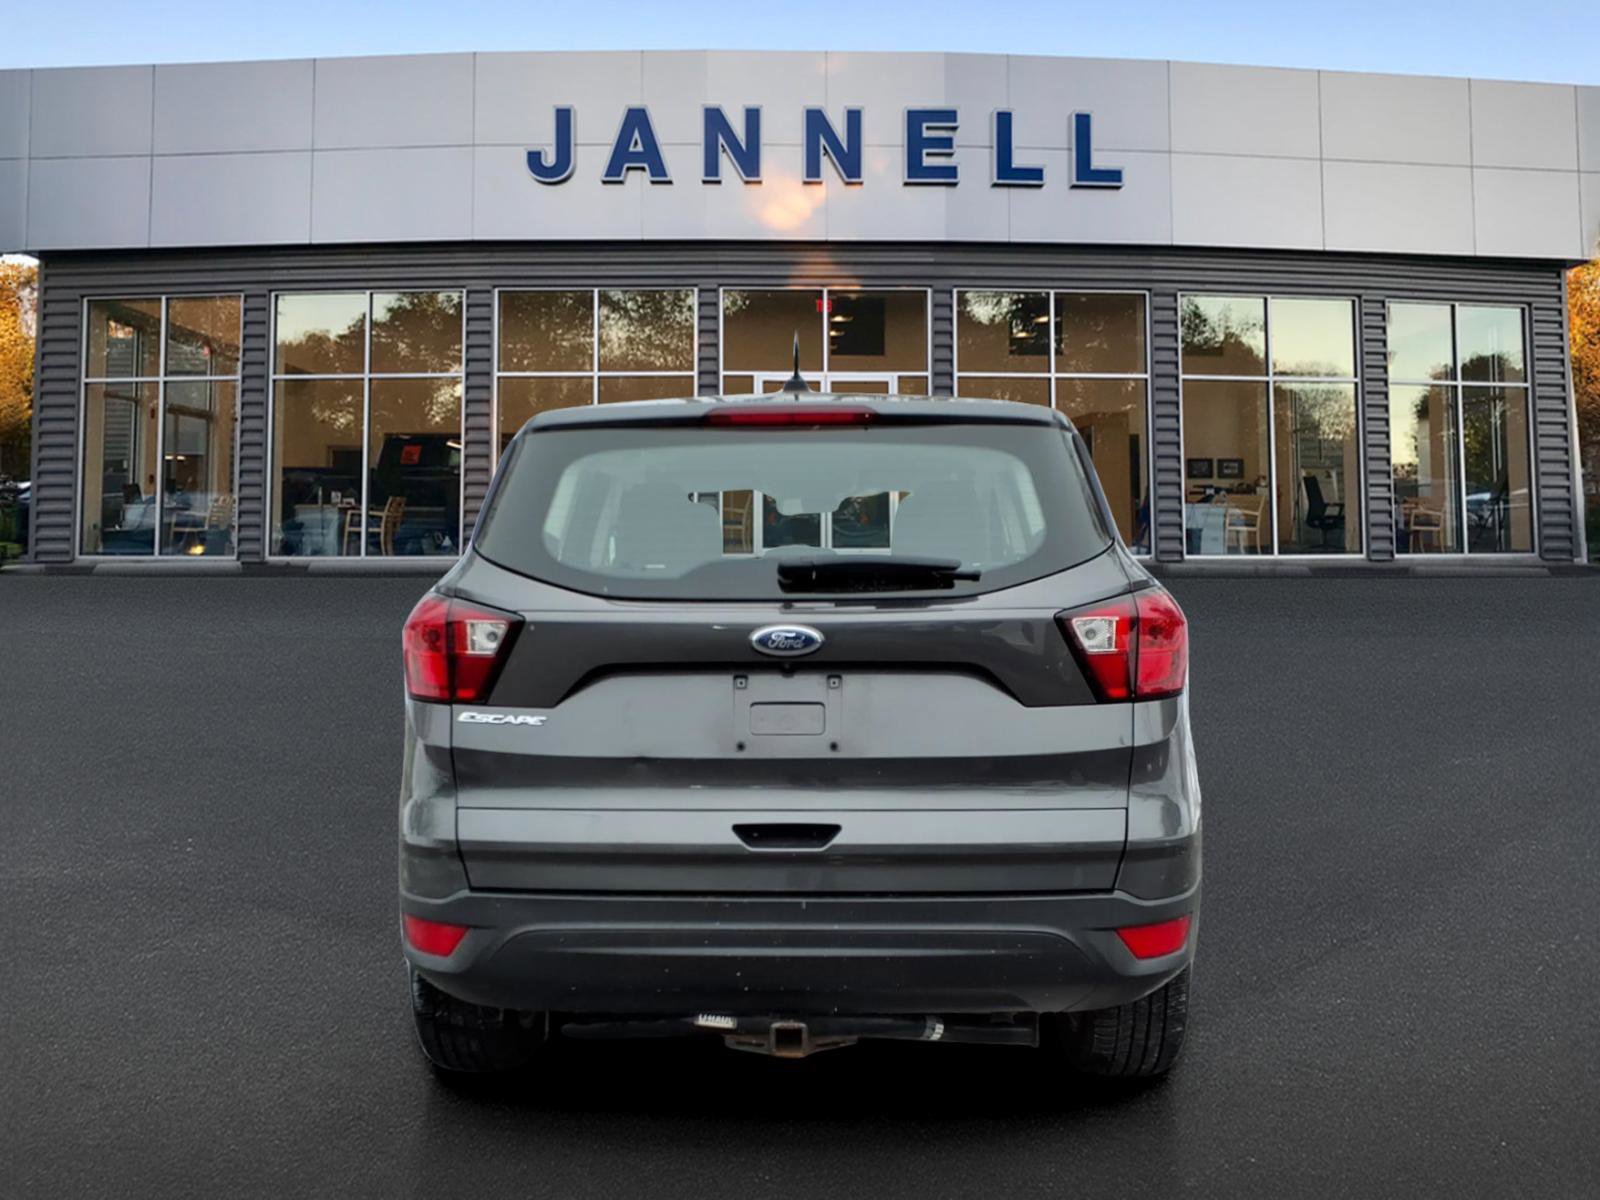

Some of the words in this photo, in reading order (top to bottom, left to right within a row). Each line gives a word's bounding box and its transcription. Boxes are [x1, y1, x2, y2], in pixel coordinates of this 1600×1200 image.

[526, 104, 1124, 188] JANNELL
[768, 632, 805, 648] Ford
[457, 712, 547, 725] ESCAPE
